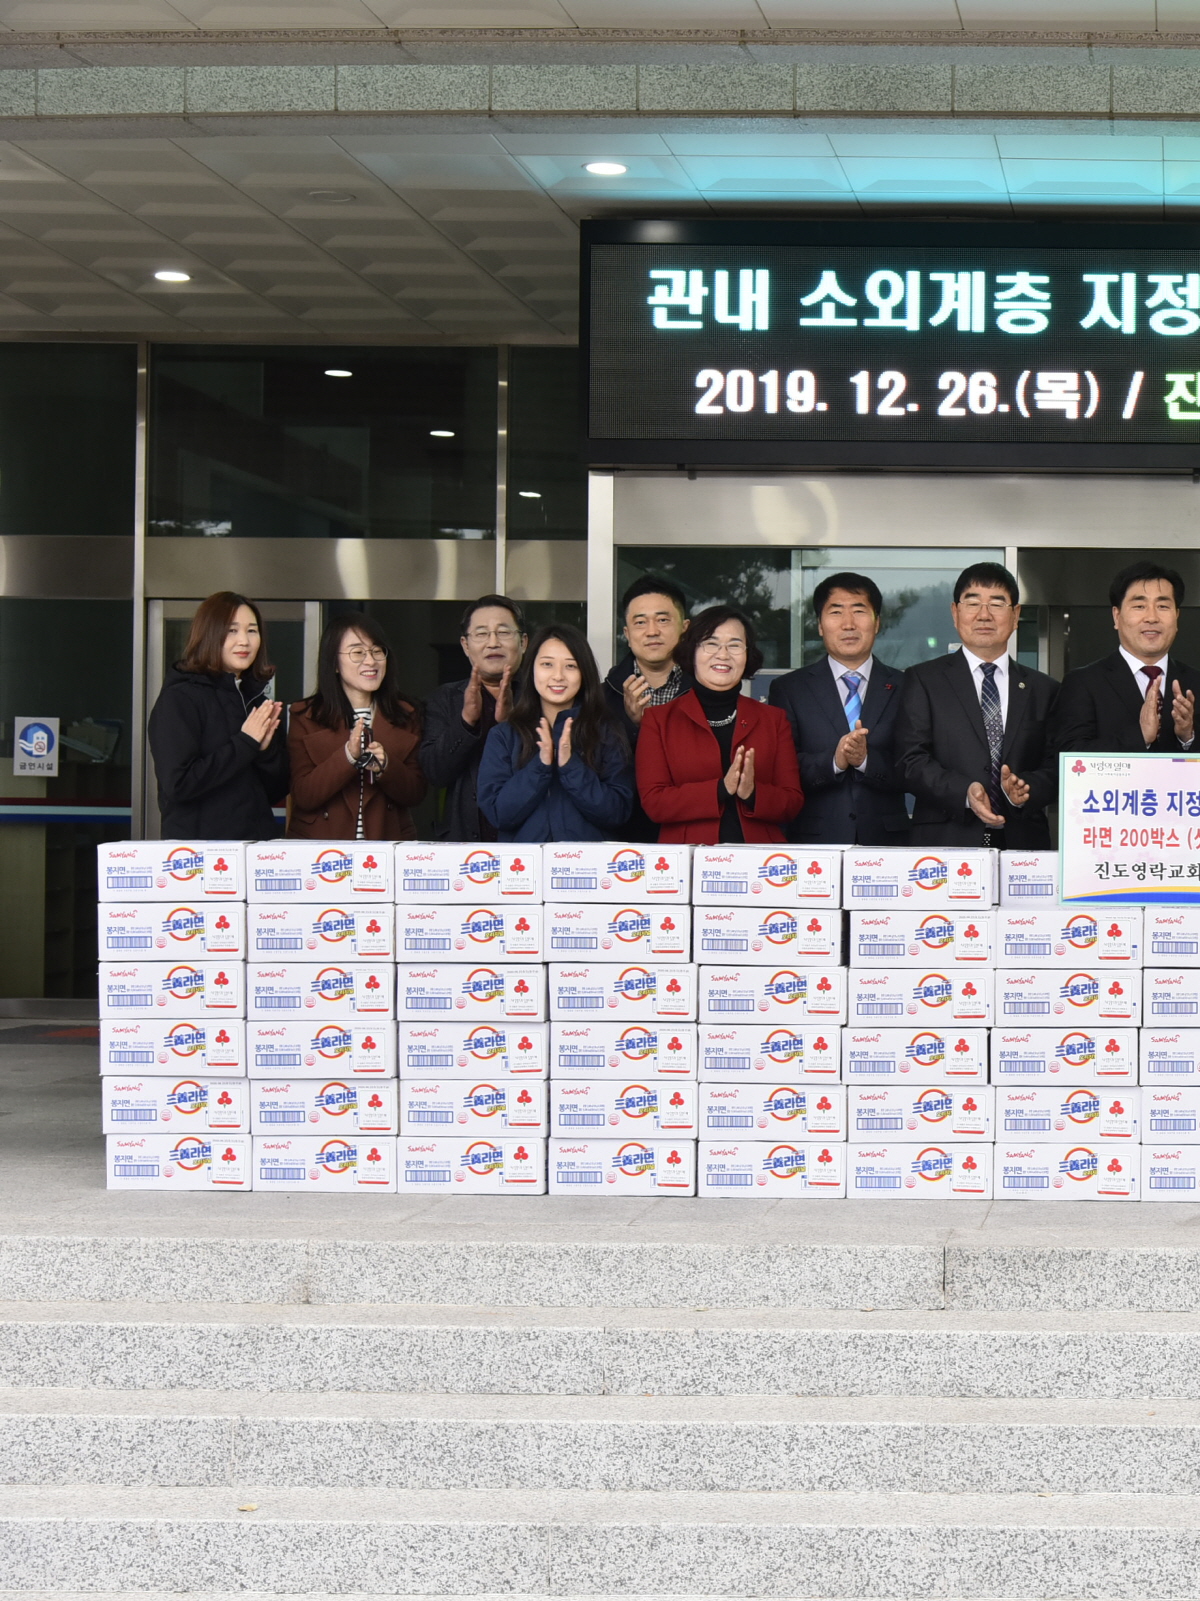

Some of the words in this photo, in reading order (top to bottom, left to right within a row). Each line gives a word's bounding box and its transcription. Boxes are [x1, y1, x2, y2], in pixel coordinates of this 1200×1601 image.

[646, 268, 770, 331] 관내
[799, 269, 1052, 335] 소외계층
[694, 369, 828, 416] 2019.
[849, 370, 919, 416] 12.
[937, 370, 1100, 420] 26.(목)
[1122, 371, 1144, 419] /
[1082, 788, 1159, 817] 소외계층
[1083, 827, 1113, 849] 라면
[1120, 827, 1181, 849] 200박스
[106, 866, 126, 876] 봉지면
[403, 869, 423, 879] 봉지면
[701, 871, 721, 881] 봉지면
[256, 927, 276, 937] 봉지면
[551, 927, 571, 937] 봉지면
[1152, 931, 1172, 941] 봉지면
[858, 933, 878, 943] 봉지면
[106, 984, 126, 994] 봉지면
[405, 987, 425, 997] 봉지면
[708, 989, 728, 999] 봉지면
[1003, 992, 1023, 1002] 봉지면
[255, 1044, 275, 1054] 봉지면
[558, 1045, 578, 1055] 봉지면
[849, 1051, 869, 1061] 봉지면
[1148, 1051, 1168, 1061] 봉지면
[111, 1099, 131, 1109] 봉지면
[407, 1101, 427, 1111] 봉지면
[707, 1105, 727, 1115] 봉지면
[1004, 1108, 1024, 1118] 봉지면
[259, 1158, 279, 1168] 봉지면
[556, 1161, 576, 1171] 봉지면
[855, 1166, 875, 1176] 봉지면
[1149, 1167, 1169, 1177] 봉지면
